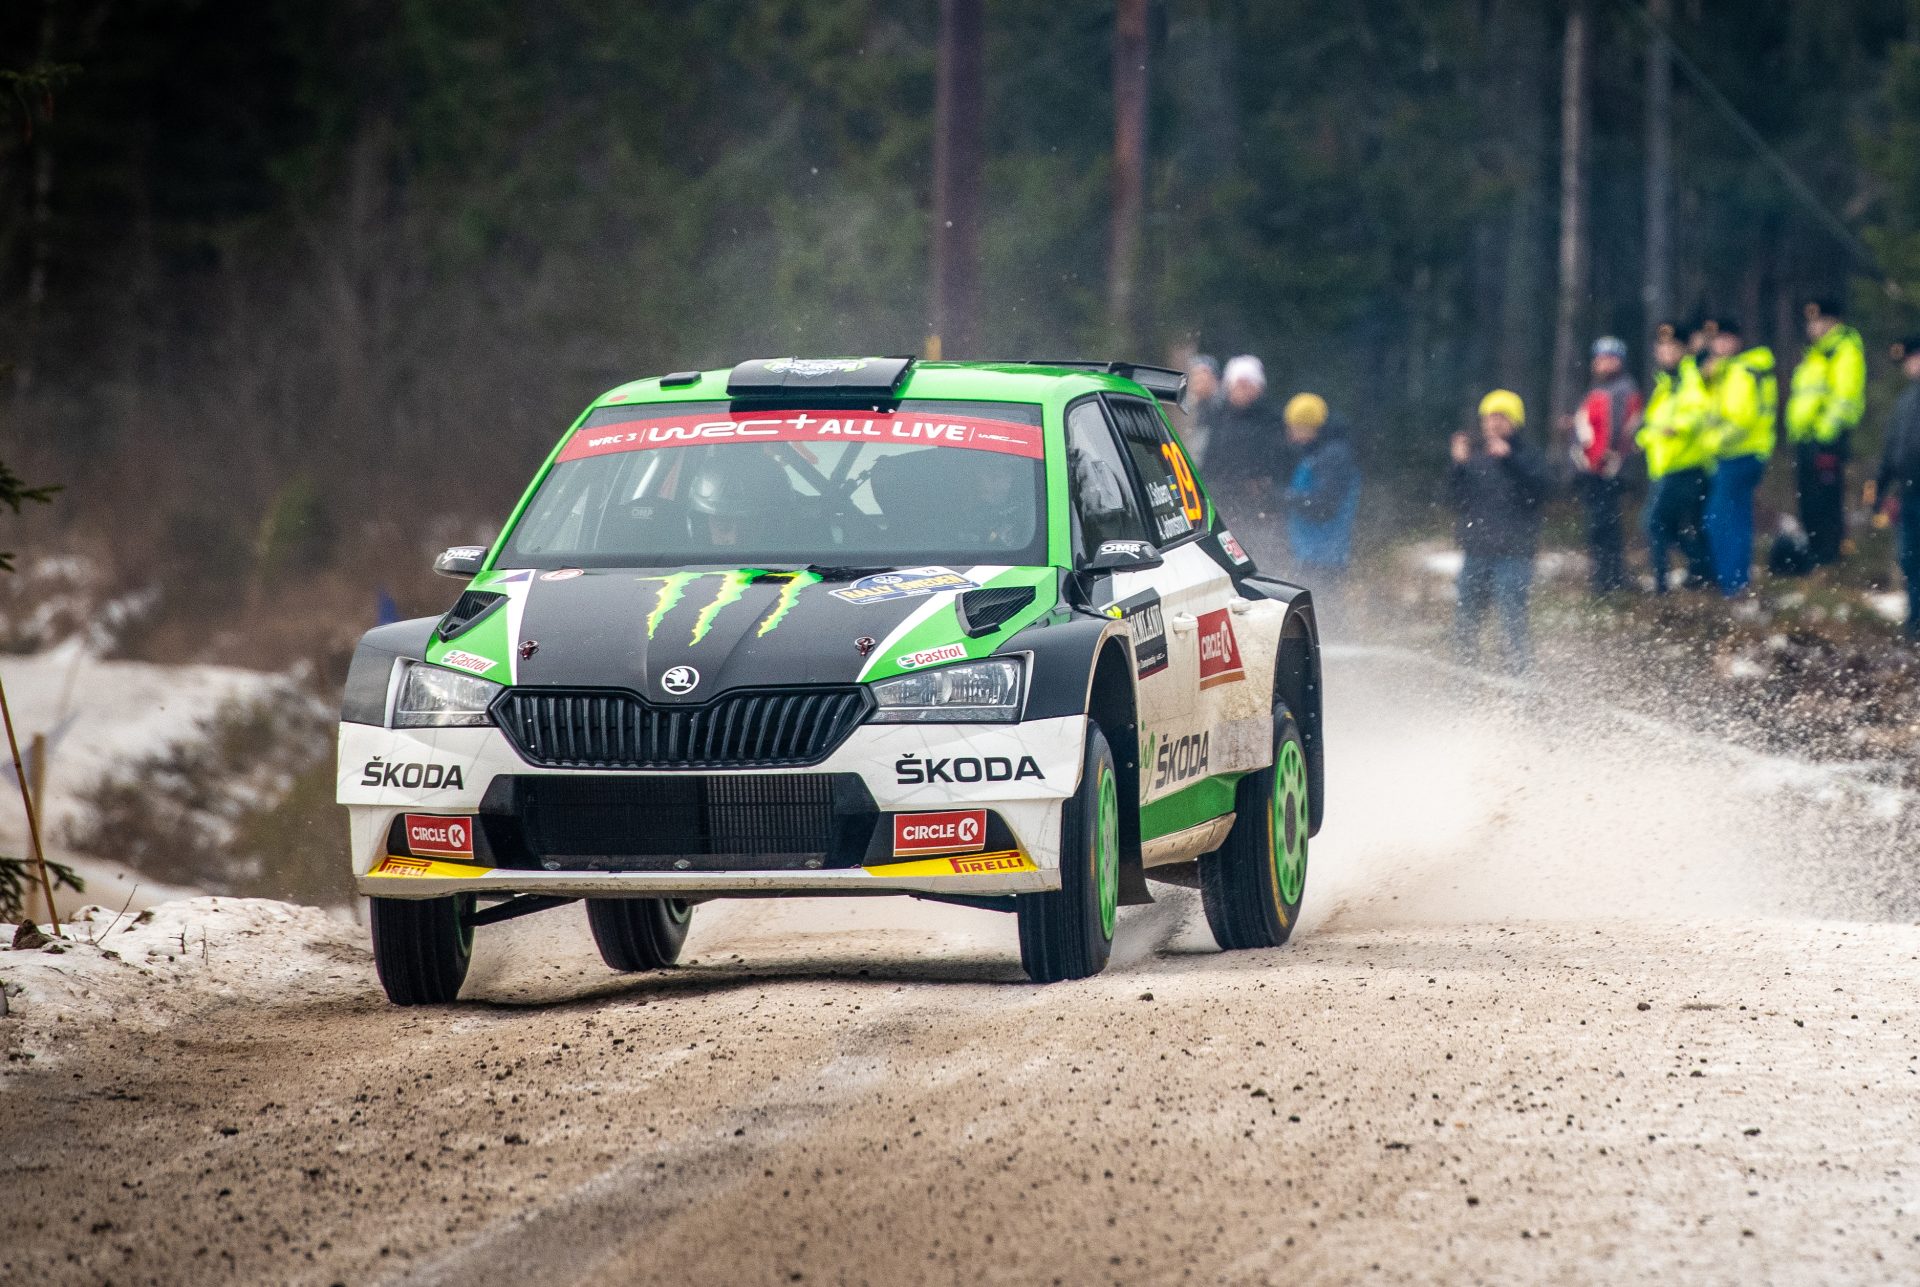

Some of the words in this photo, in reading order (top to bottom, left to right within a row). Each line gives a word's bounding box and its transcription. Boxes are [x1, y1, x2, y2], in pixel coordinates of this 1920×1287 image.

[589, 434, 623, 447] WRC
[626, 433, 637, 441] 3
[818, 419, 881, 435] ALL
[892, 422, 966, 440] LIVE
[445, 549, 482, 561] OMP
[1101, 543, 1141, 554] OMP
[838, 584, 895, 599] RALLY
[894, 573, 967, 591] SWEDEN
[1201, 633, 1222, 661] CIRCLE
[1221, 622, 1232, 662] K
[451, 653, 493, 672] Castrol
[915, 645, 964, 665] Castrol
[895, 753, 1046, 785] ŠKODA
[1155, 731, 1209, 790] ŠKODA
[360, 756, 464, 790] ŠKODA
[411, 826, 447, 842] CIRCLE
[449, 825, 465, 847] K
[903, 823, 955, 840] CIRCLE
[959, 819, 978, 841] K
[378, 857, 433, 877] PIRELLI
[950, 851, 1025, 874] PIRELLI
